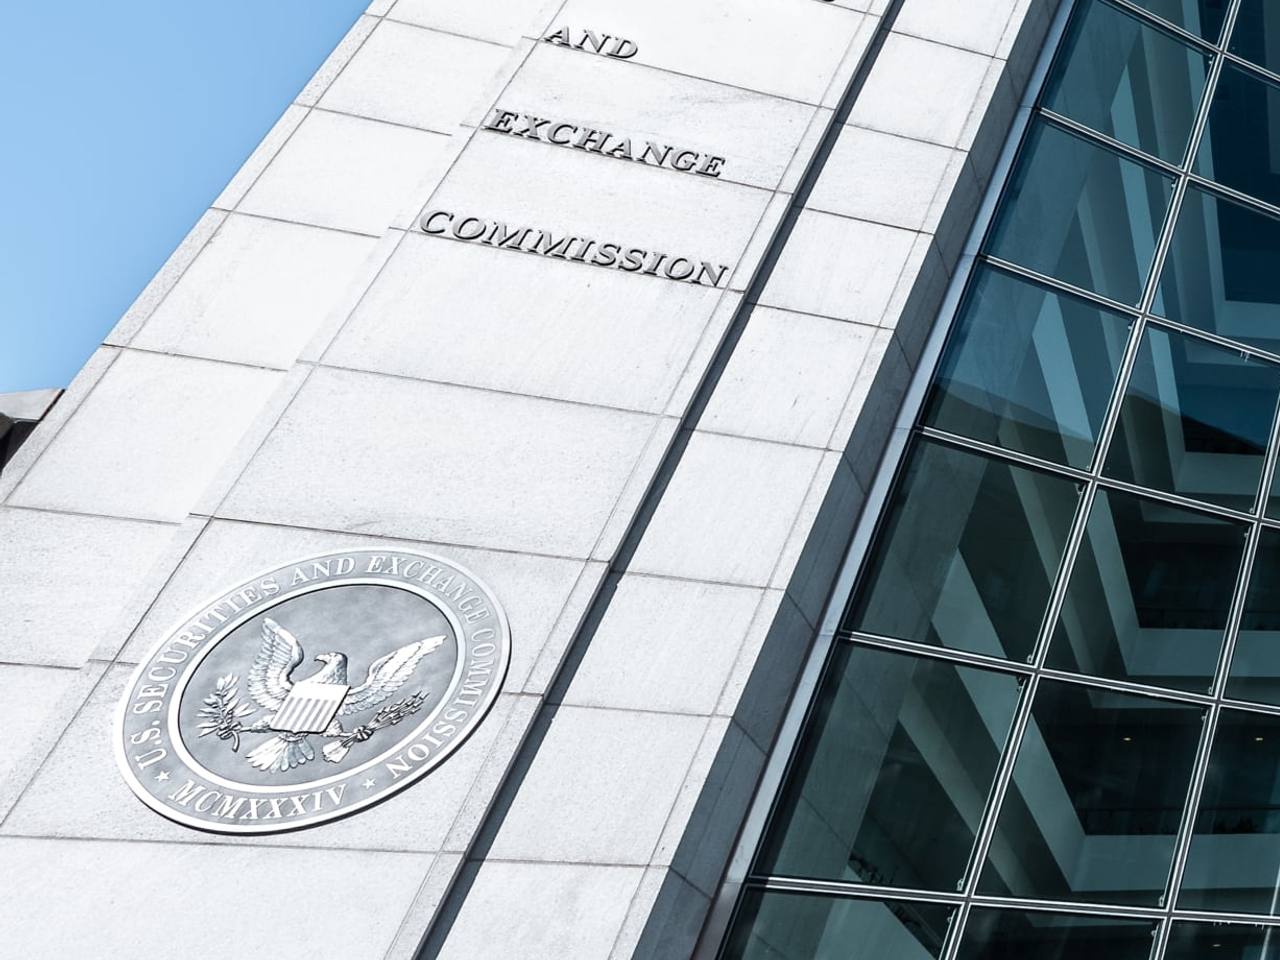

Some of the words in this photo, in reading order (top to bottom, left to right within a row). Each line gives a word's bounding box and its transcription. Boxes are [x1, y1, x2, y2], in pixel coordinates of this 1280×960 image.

[543, 25, 638, 59] AND
[483, 108, 726, 178] EXCHANGE
[418, 210, 729, 287] COMMISSION
[289, 556, 356, 587] AND
[366, 554, 491, 623] EXCHANGE
[134, 577, 280, 714] SECURITIES
[385, 628, 497, 781] COMMISSION
[167, 779, 349, 820] MCMXXXIV
